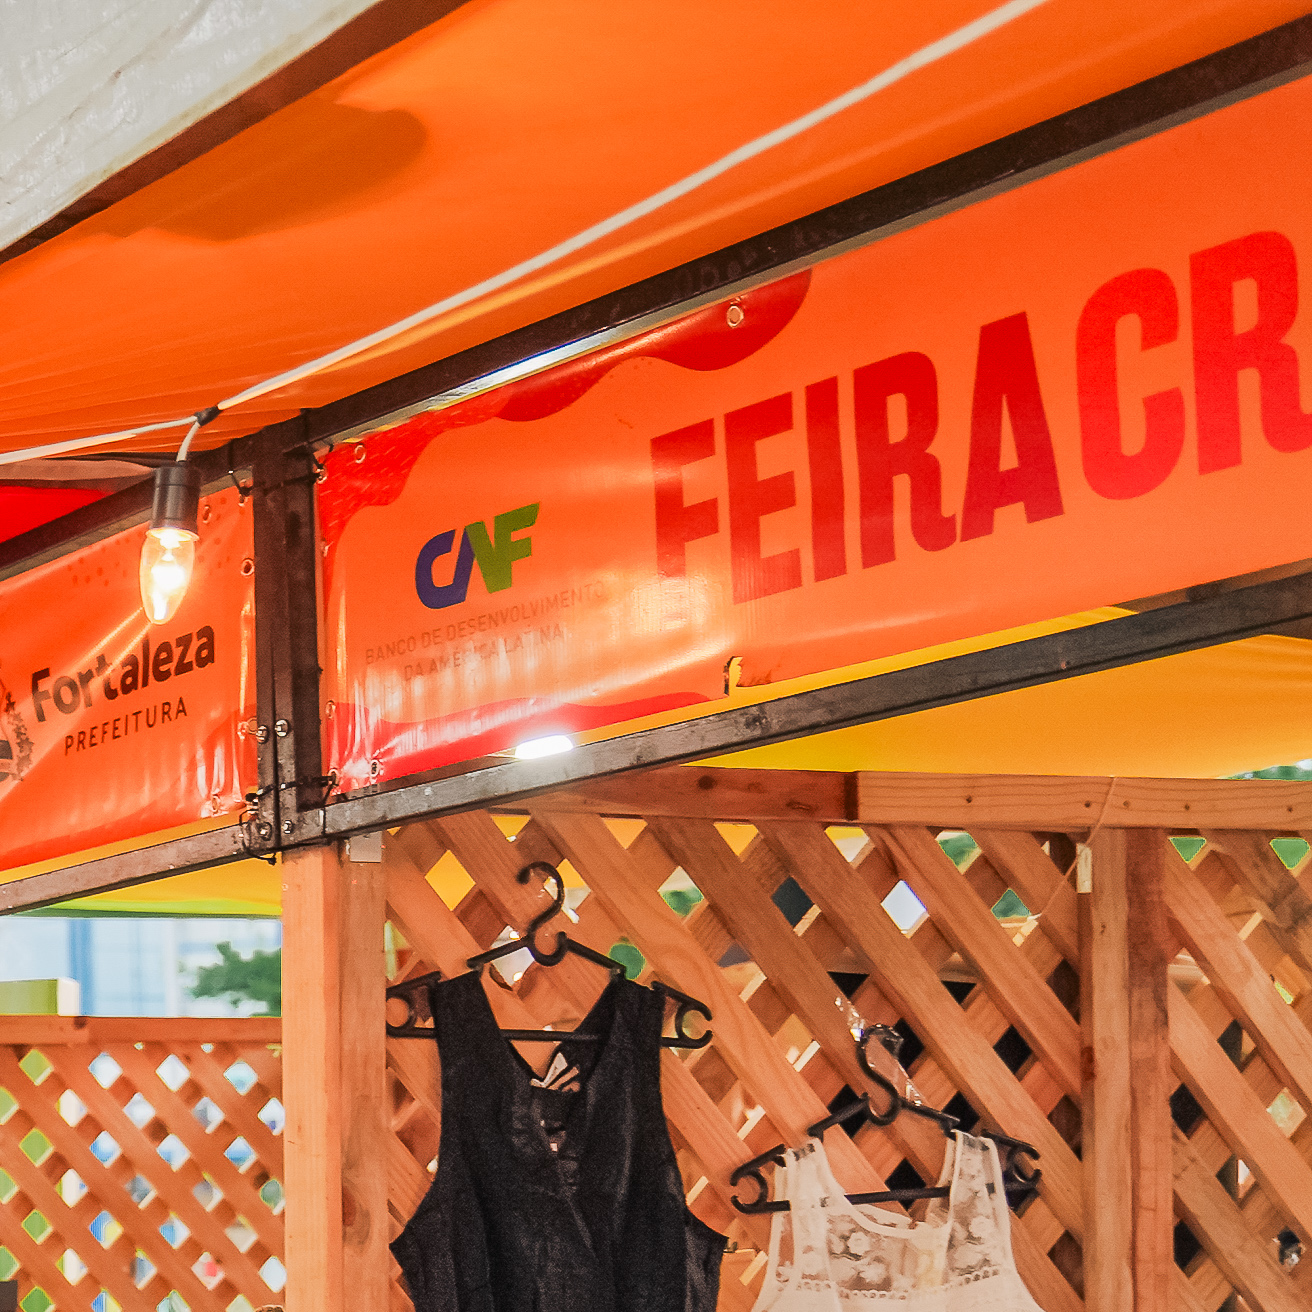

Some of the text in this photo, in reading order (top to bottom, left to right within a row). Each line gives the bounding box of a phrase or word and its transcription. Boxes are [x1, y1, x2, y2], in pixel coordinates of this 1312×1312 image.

[649, 310, 1065, 606] FEIRA
[414, 501, 542, 611] CAF
[365, 580, 609, 666] BANCO DE DESENVOLVIMENTO
[31, 624, 216, 724] Fortaleza
[64, 696, 188, 757] PREFEITURA
